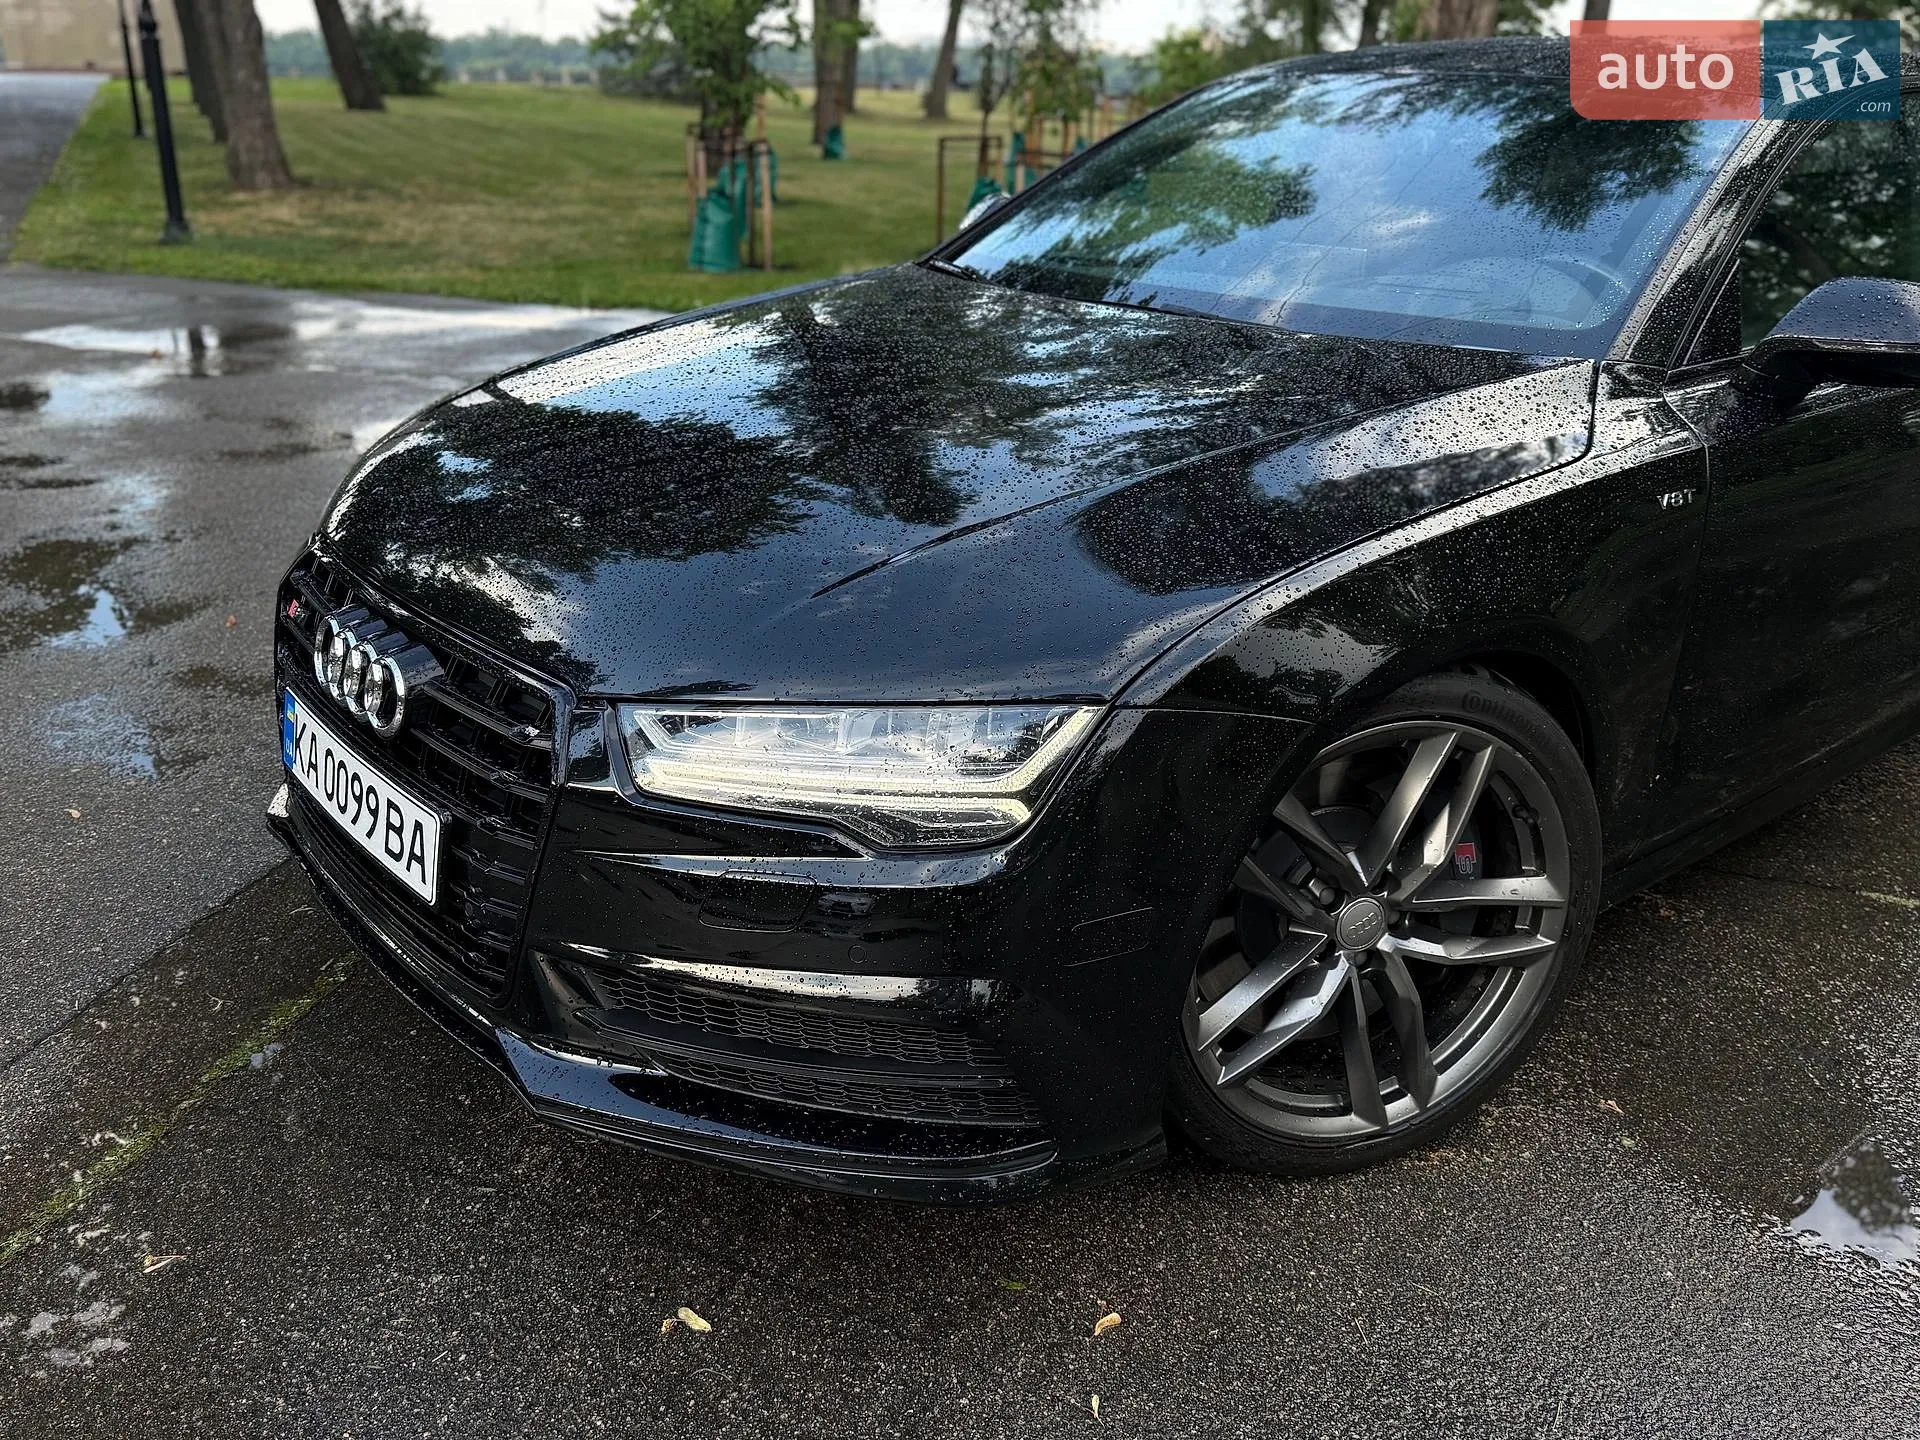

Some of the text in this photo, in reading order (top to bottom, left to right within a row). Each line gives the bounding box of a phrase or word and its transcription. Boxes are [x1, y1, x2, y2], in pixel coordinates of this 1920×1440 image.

[1656, 488, 1697, 510] V8T
[294, 713, 428, 886] KA 0099 BA
